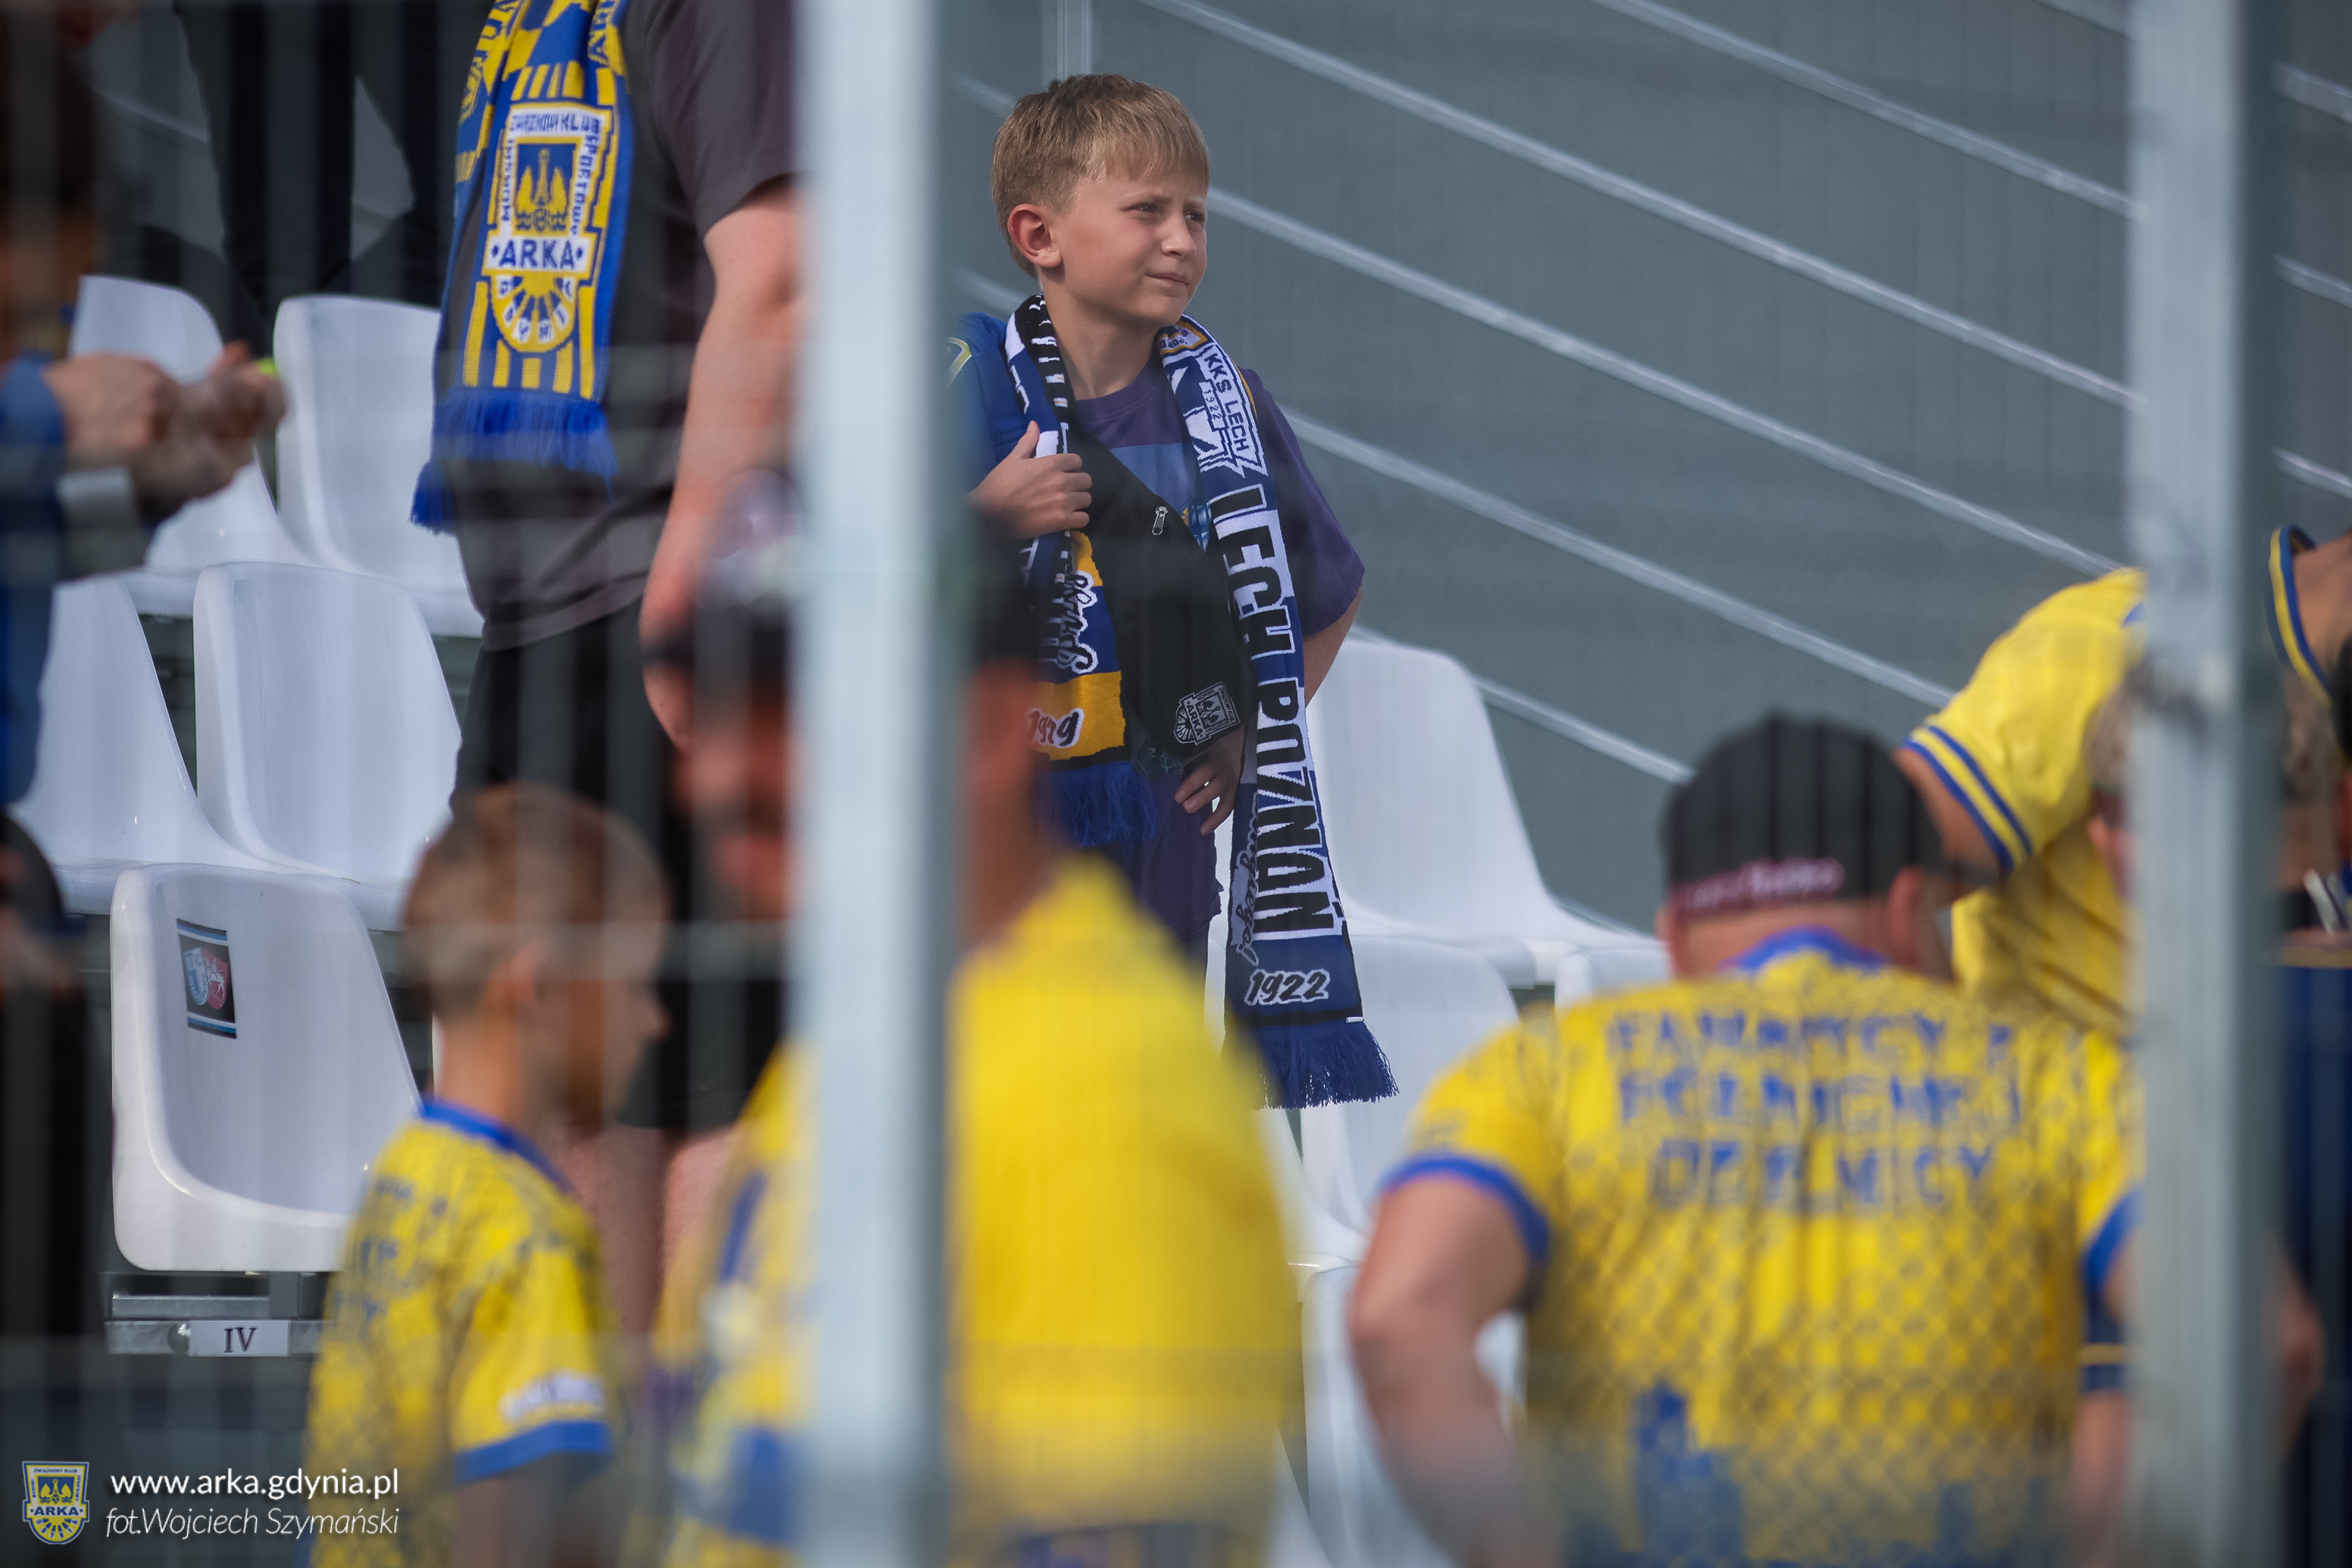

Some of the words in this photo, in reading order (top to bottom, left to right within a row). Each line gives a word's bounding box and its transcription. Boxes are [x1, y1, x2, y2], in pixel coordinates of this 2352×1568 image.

[499, 239, 575, 269] ARKA
[1203, 389, 1222, 420] 1922
[1204, 353, 1232, 393] KKS
[1224, 400, 1250, 452] LECH
[1208, 483, 1296, 661] LECH
[1186, 704, 1203, 737] ARKA
[1244, 969, 1331, 1006] 1922
[222, 1327, 257, 1354] IV
